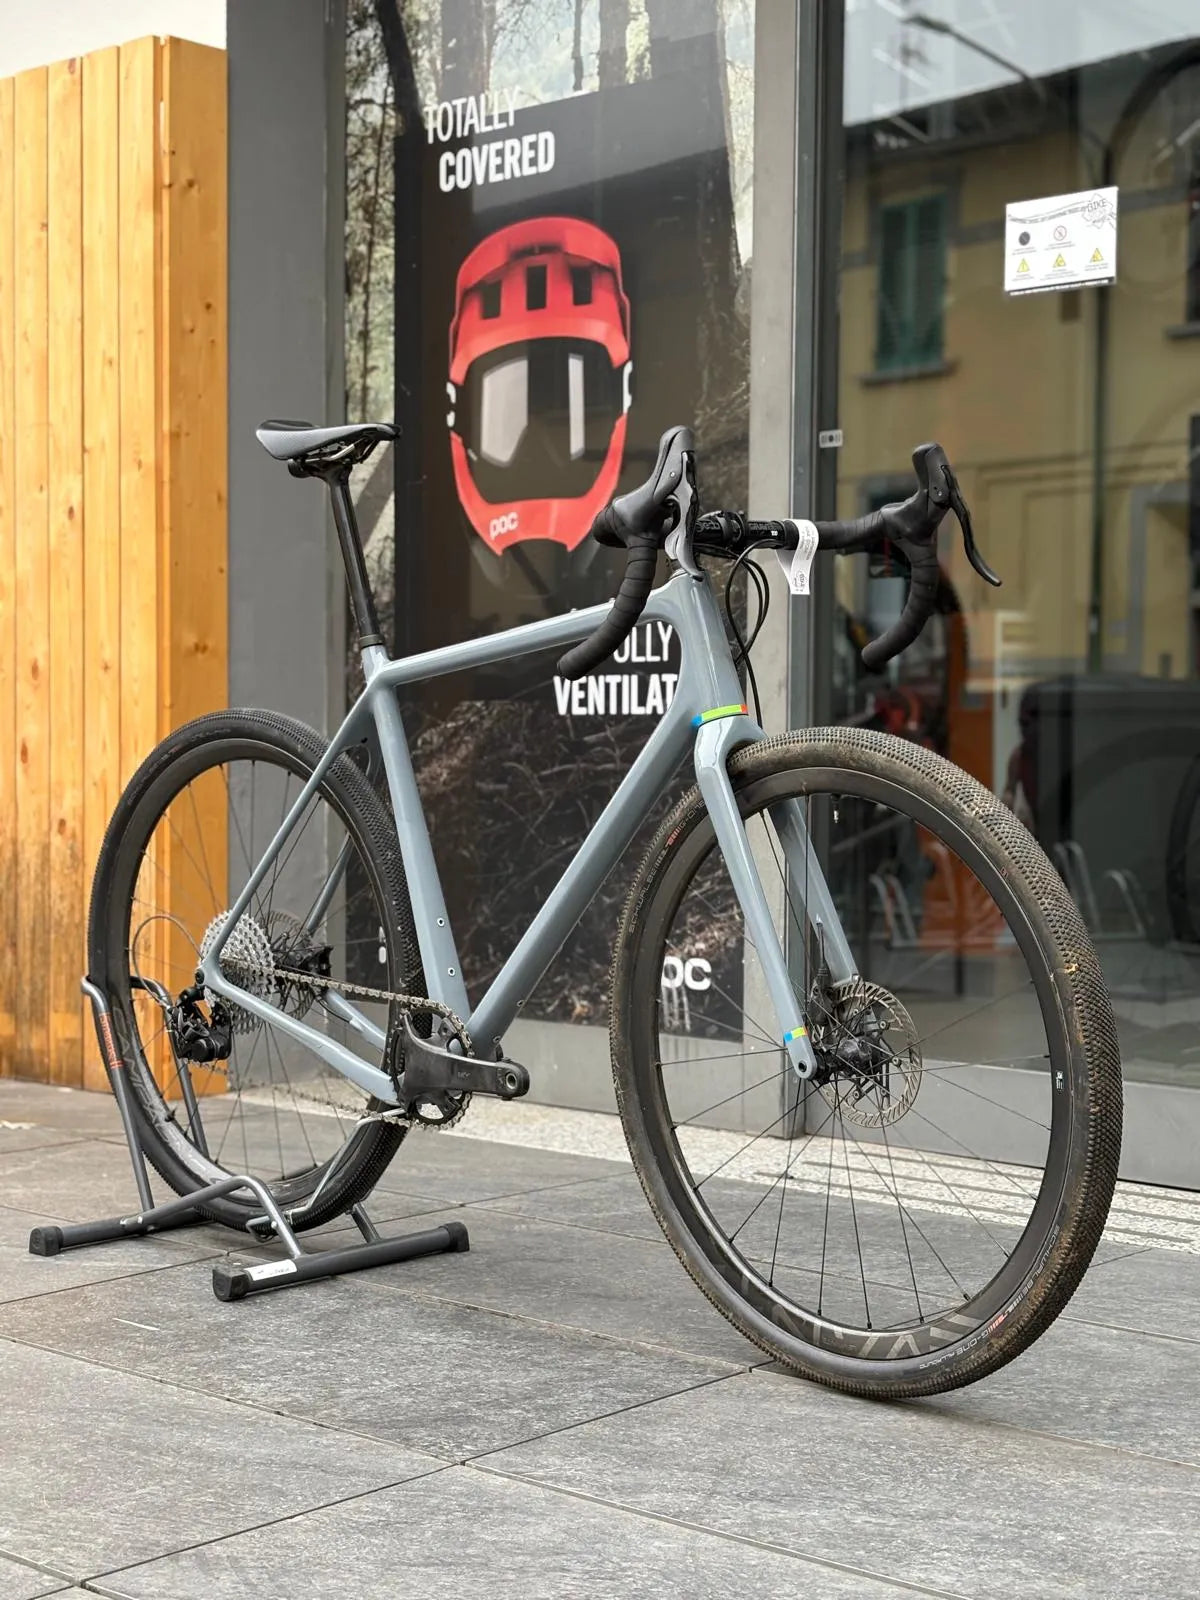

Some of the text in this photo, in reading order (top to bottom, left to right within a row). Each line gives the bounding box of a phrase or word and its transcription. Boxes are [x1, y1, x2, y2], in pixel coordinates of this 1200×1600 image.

[424, 86, 521, 143] TOTALLY
[439, 131, 555, 192] COVERED
[613, 621, 673, 663] ULLY
[553, 673, 678, 716] VENTILAT
[1020, 1224, 1061, 1295] SCHWALBE
